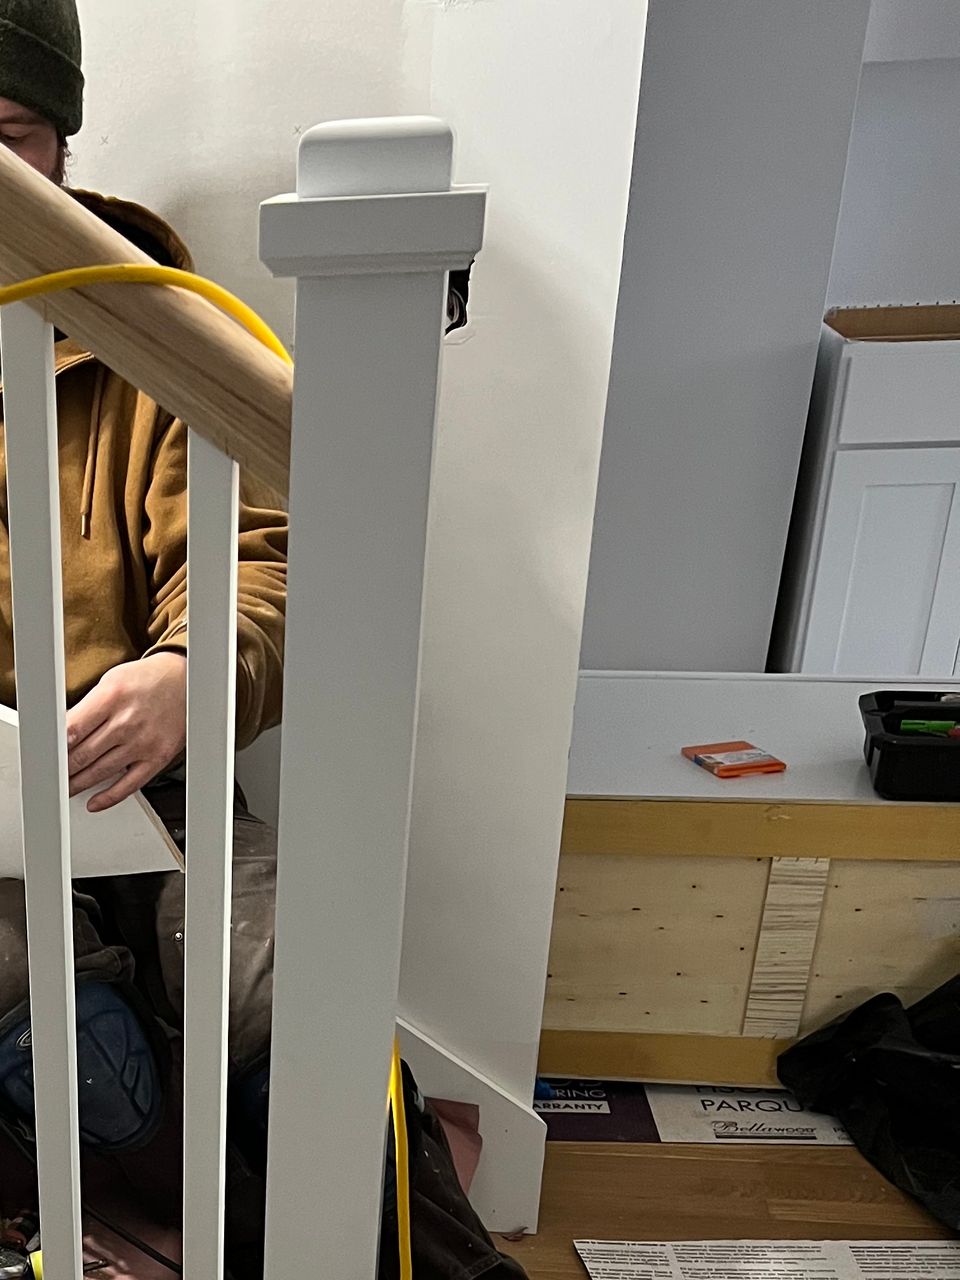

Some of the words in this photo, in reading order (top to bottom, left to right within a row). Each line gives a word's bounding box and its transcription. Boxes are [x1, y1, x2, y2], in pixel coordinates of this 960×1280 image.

[555, 1088, 607, 1098] RING
[532, 1102, 603, 1111] ARRANTY
[700, 1098, 804, 1113] PARQU
